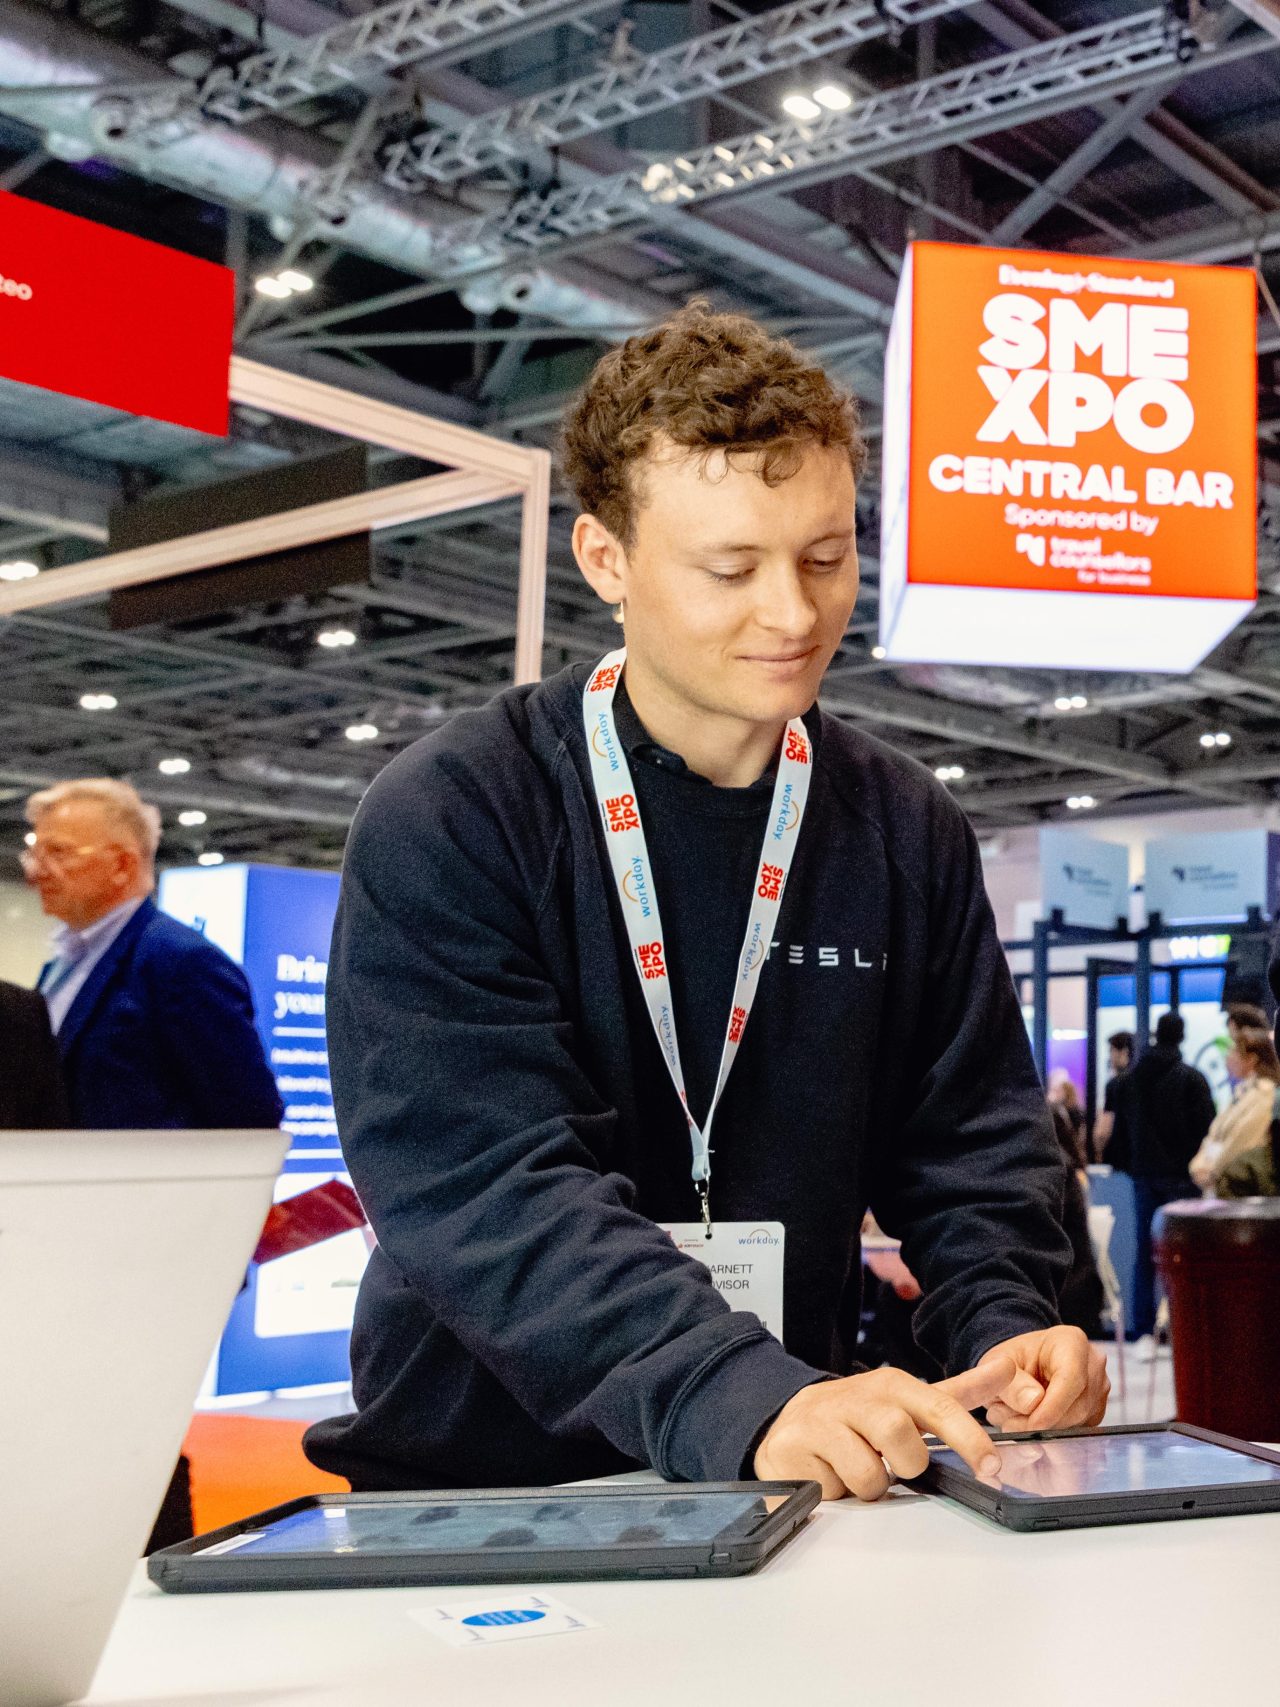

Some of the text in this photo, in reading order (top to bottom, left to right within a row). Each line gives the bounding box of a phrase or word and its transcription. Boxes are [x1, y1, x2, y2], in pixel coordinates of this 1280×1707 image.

[978, 293, 1188, 381] SME
[976, 365, 1194, 454] XPO
[929, 454, 1234, 509] CENTRAL BAR
[1005, 503, 1159, 536] Sponsored by
[605, 797, 626, 833] SME
[621, 794, 640, 831] XPO
[757, 862, 774, 899] XPO
[767, 866, 784, 902] SME
[637, 943, 654, 980] SME
[649, 941, 666, 979] XPO
[765, 940, 888, 971] TESL
[707, 1264, 753, 1275] ARNETT
